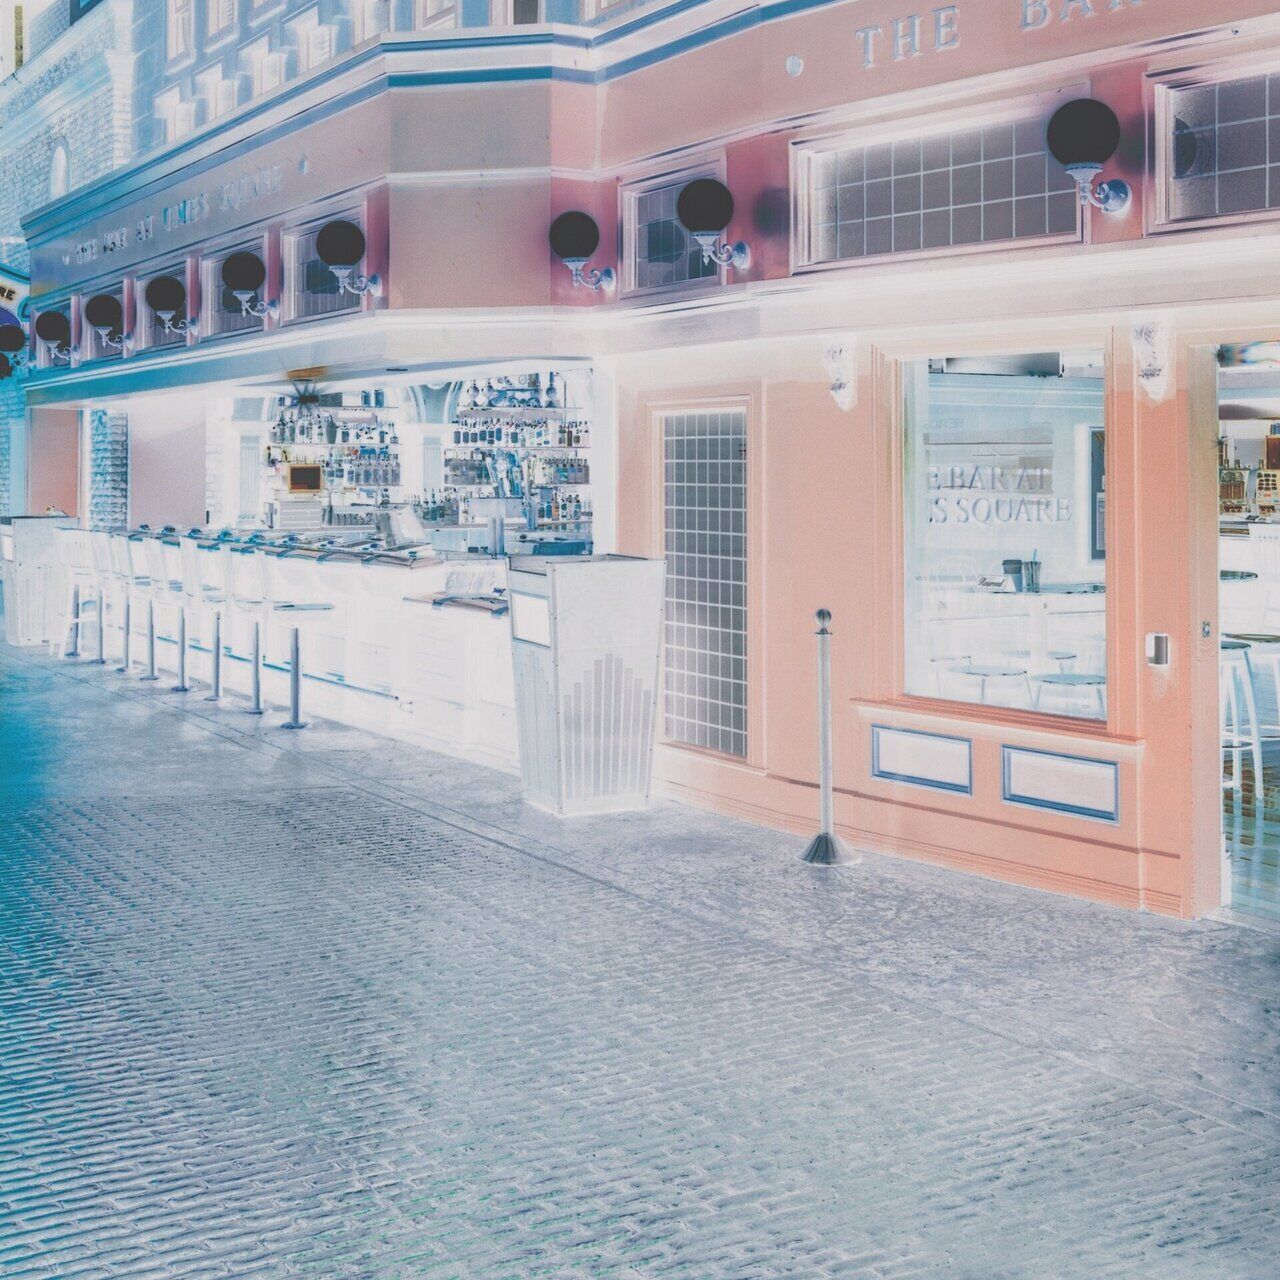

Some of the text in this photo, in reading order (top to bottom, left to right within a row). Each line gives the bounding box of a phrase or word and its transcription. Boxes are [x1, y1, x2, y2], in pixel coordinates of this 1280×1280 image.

[856, 4, 962, 70] THE
[949, 465, 1011, 491] BAR
[1016, 465, 1051, 491] AT
[955, 497, 1072, 524] SQUARE
